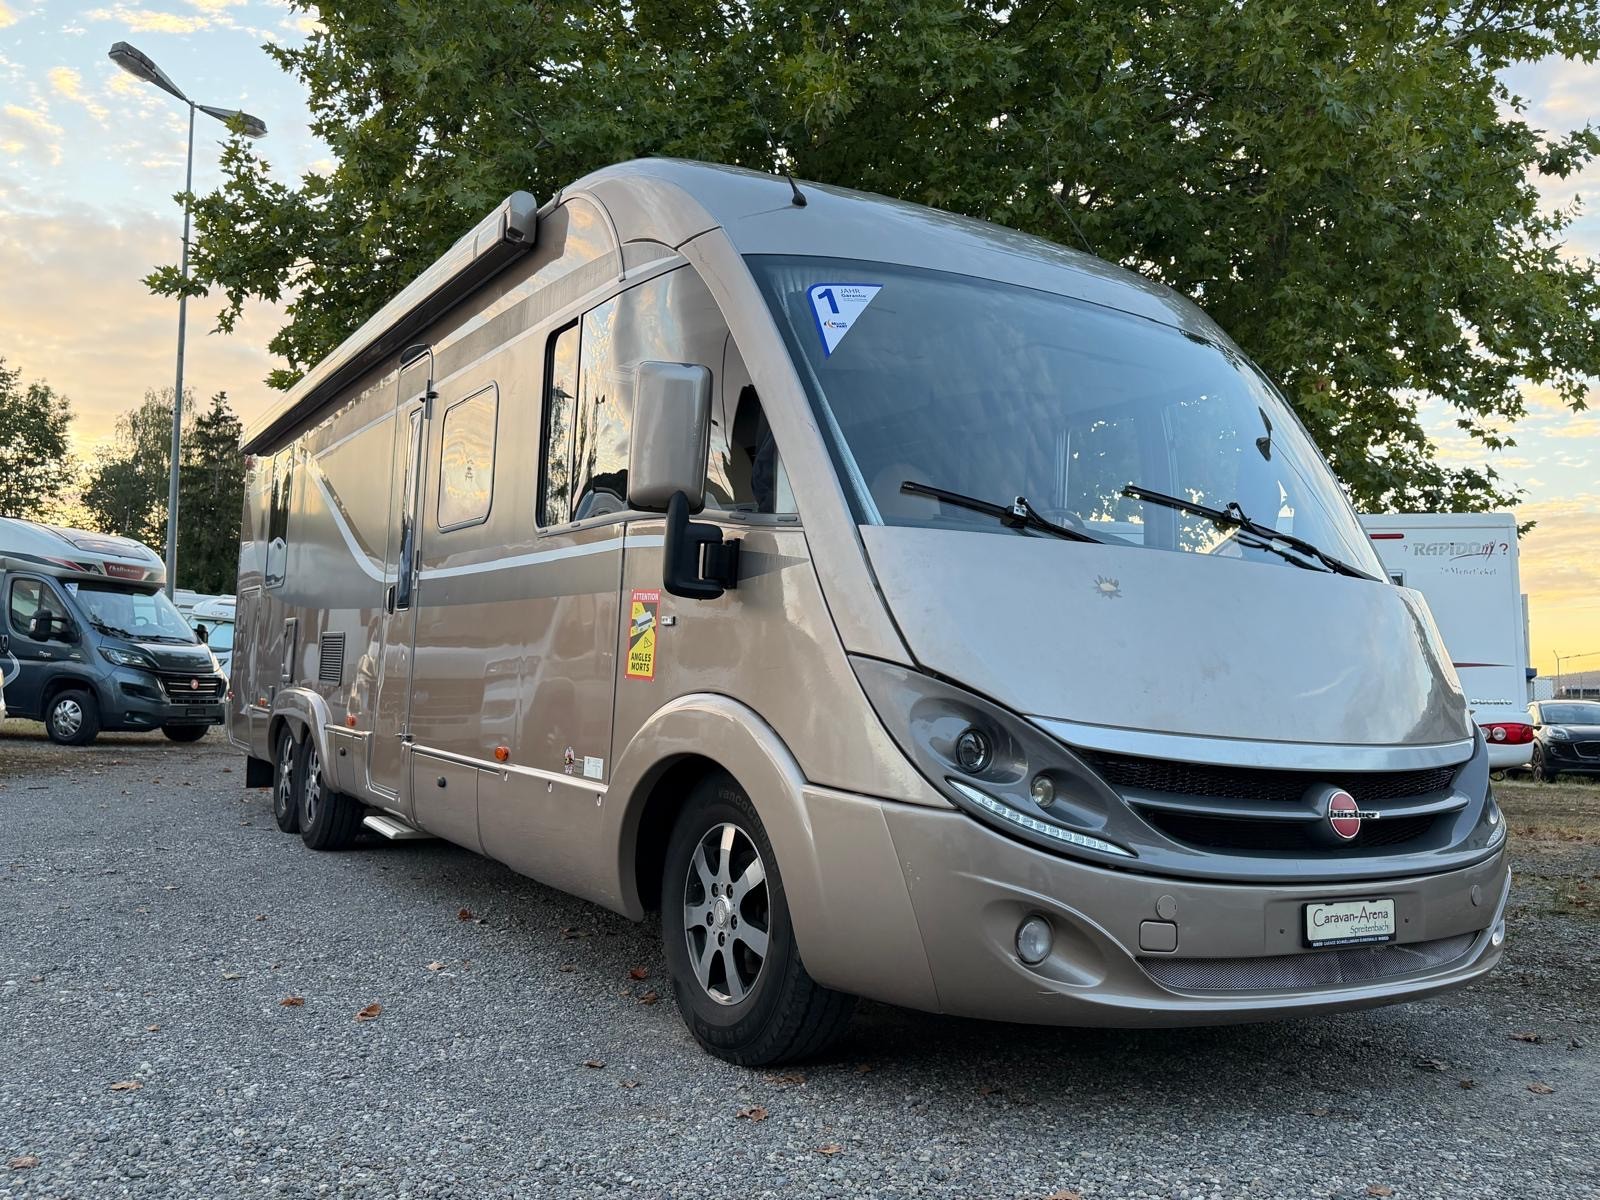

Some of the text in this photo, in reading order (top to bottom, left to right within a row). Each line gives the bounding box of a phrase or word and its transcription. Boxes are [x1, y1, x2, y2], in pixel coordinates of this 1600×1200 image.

[817, 288, 840, 314] 1
[632, 592, 659, 601] ATTENTION
[630, 652, 652, 662] ANGLES
[630, 661, 650, 672] MORTS
[1313, 905, 1389, 927] Caravan-Arena
[1350, 920, 1389, 937] Spreitenbach
